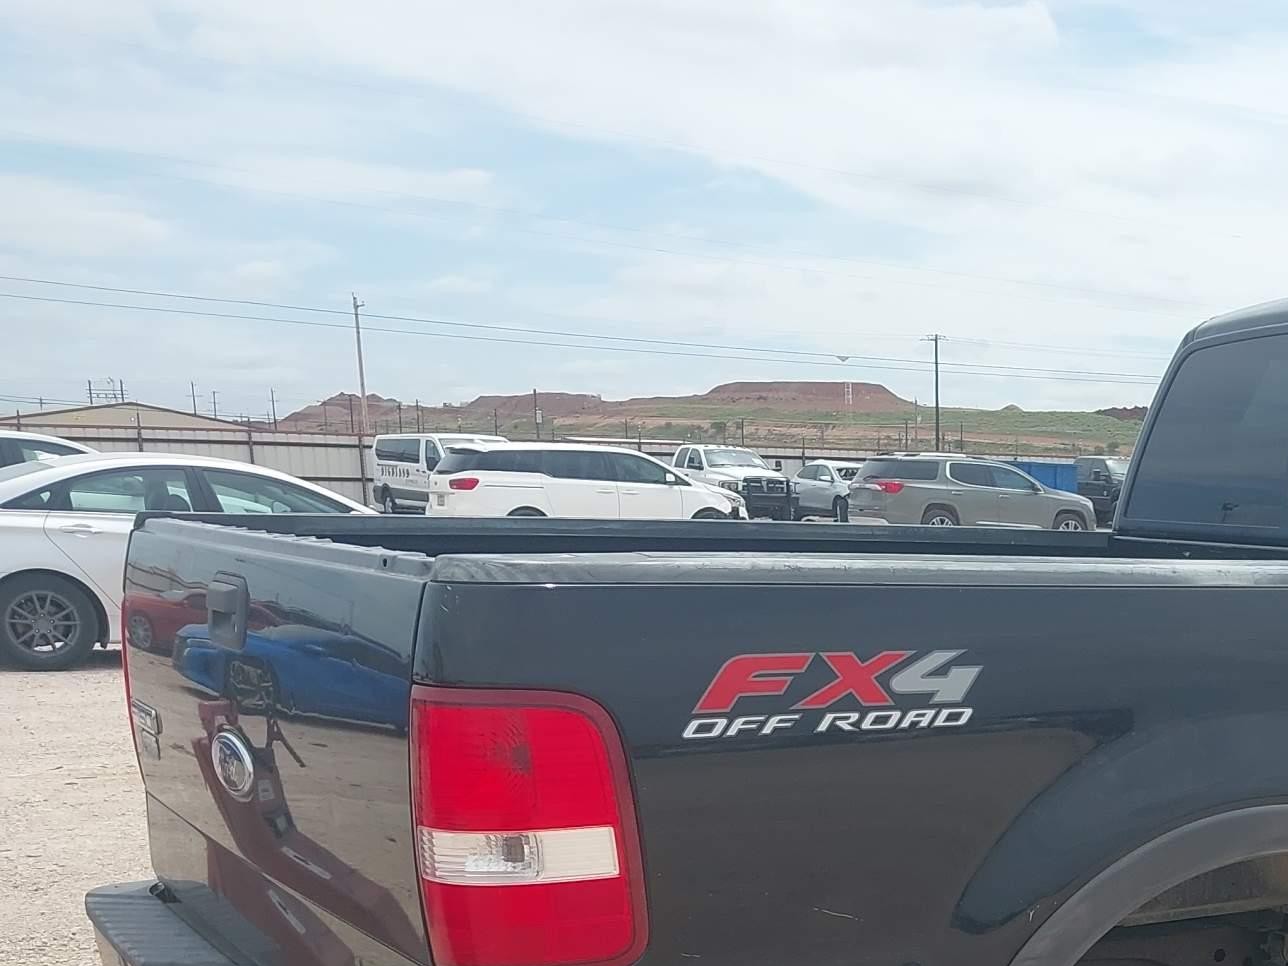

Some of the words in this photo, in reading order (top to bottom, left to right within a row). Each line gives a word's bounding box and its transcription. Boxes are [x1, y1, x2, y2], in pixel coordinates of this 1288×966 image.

[691, 649, 984, 714] FX4
[682, 713, 804, 740] OFF
[813, 707, 975, 734] ROAD
